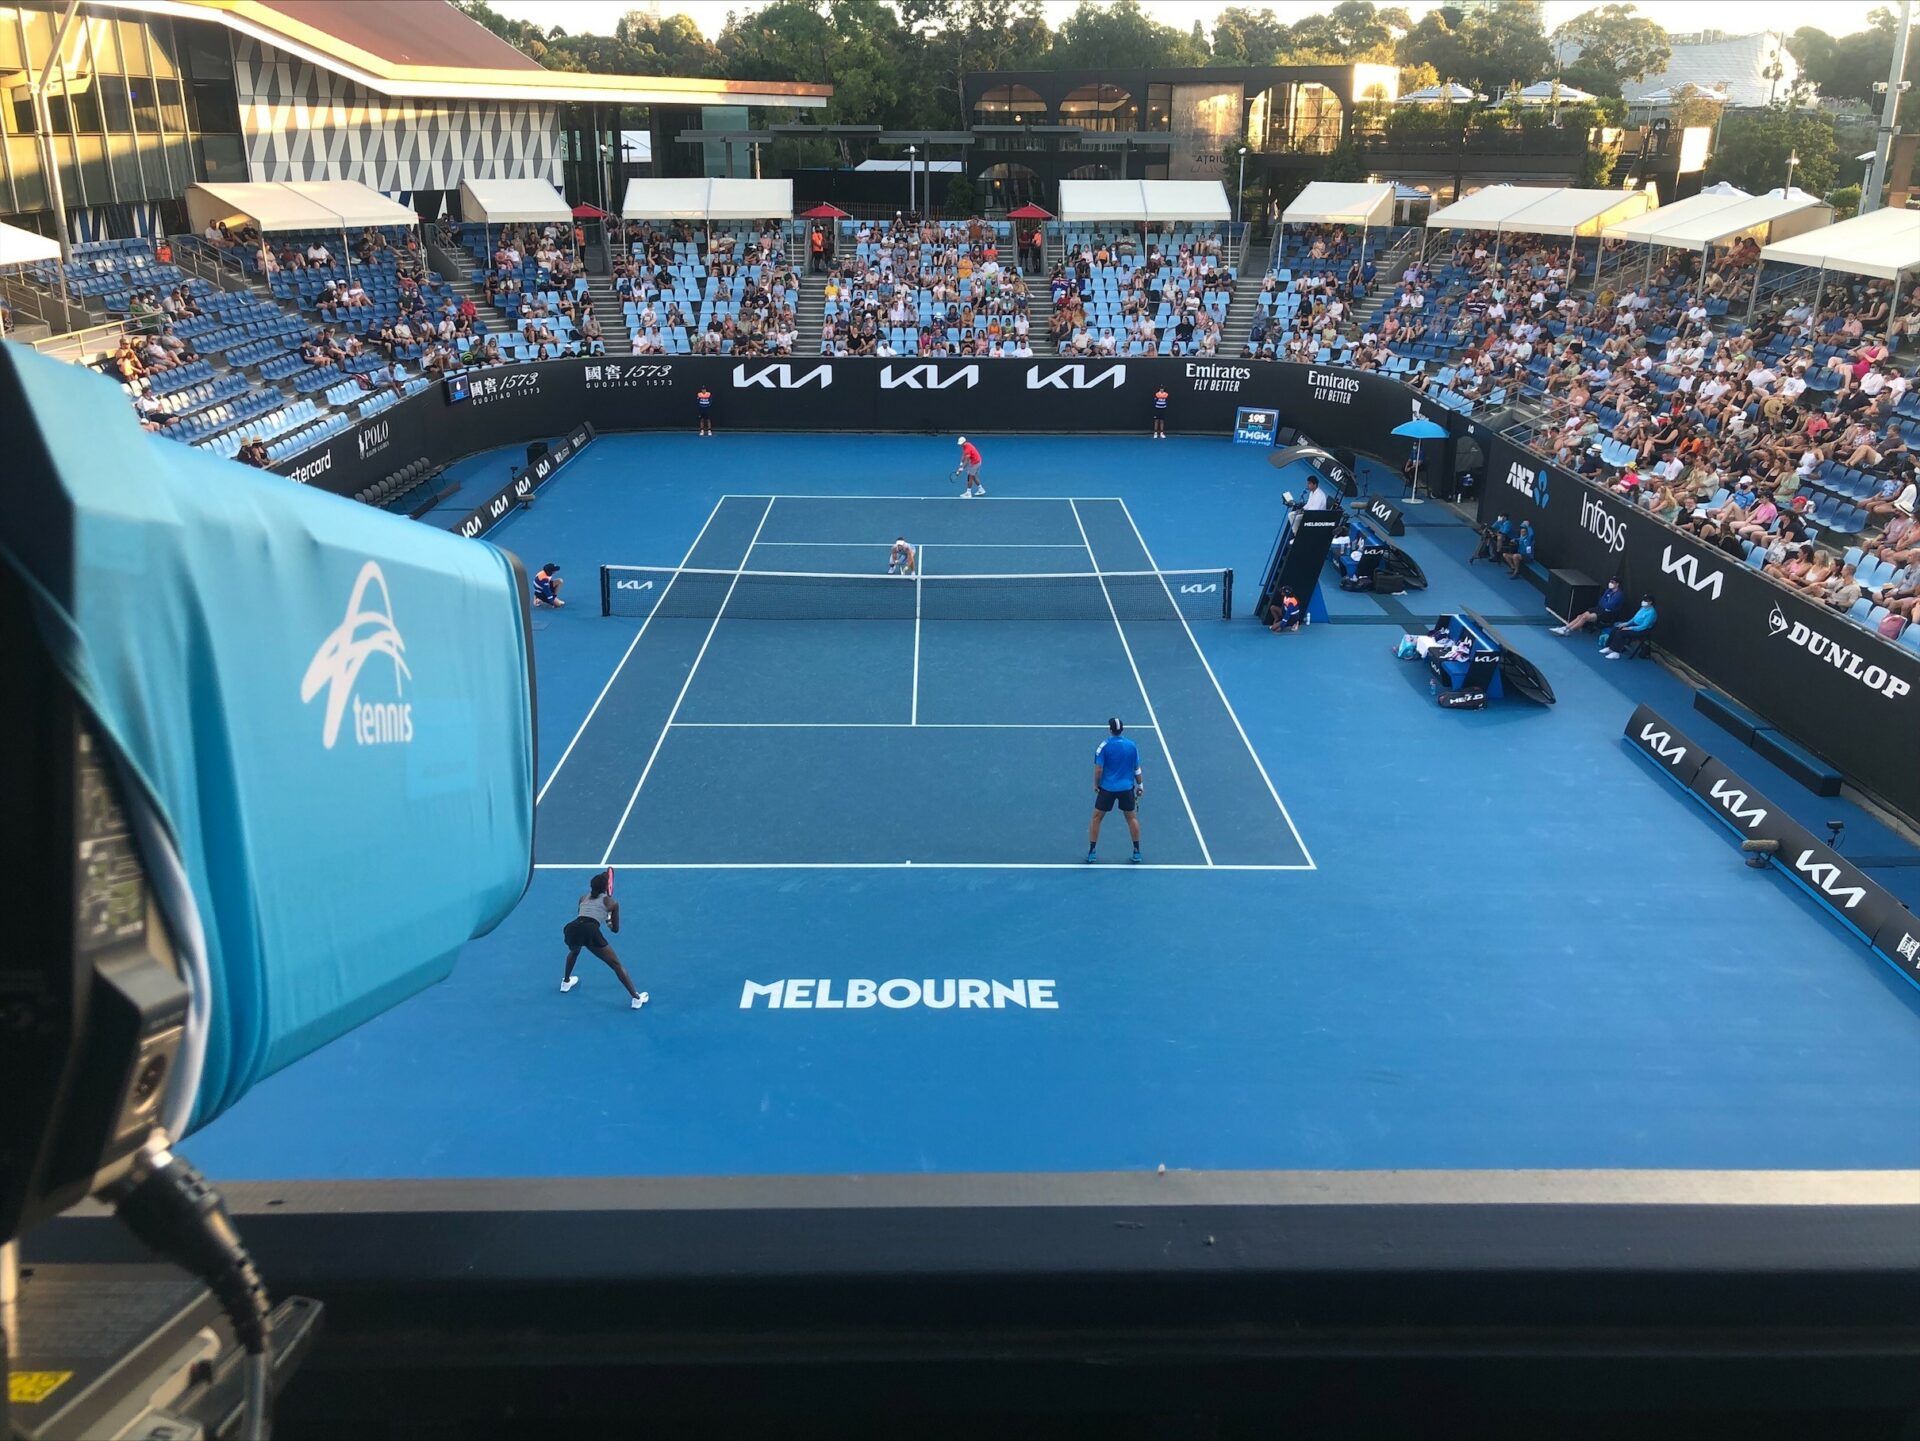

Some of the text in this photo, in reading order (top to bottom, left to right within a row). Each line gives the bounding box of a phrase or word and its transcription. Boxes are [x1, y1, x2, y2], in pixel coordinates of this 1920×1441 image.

[499, 372, 539, 390] 1573
[624, 365, 672, 378] 1573
[646, 379, 673, 387] 1573
[732, 364, 832, 388] KIA
[880, 364, 979, 389] KIA
[1026, 364, 1126, 389] KIA
[1185, 363, 1251, 380] Emirates
[1308, 370, 1360, 392] Emirates
[1194, 379, 1240, 392] FLY BETTER
[1314, 387, 1352, 405] FLY BETTER
[364, 420, 389, 450] POLO
[536, 459, 550, 478] KIA
[1507, 462, 1534, 498] ANZ
[515, 476, 531, 496] KIA
[490, 495, 508, 518] KIA
[1371, 501, 1392, 521] KIA
[461, 516, 482, 539] KIA
[1580, 491, 1627, 552] Infosys
[1661, 545, 1723, 600] KIA
[617, 580, 652, 589] KIA
[1181, 584, 1216, 593] KIA
[1787, 621, 1910, 699] DUNLOP
[353, 694, 413, 744] tennis
[1640, 722, 1687, 765] KIA
[1709, 779, 1767, 828] KIA
[1795, 850, 1867, 908] KIA
[739, 979, 1059, 1009] MELBOURNE
